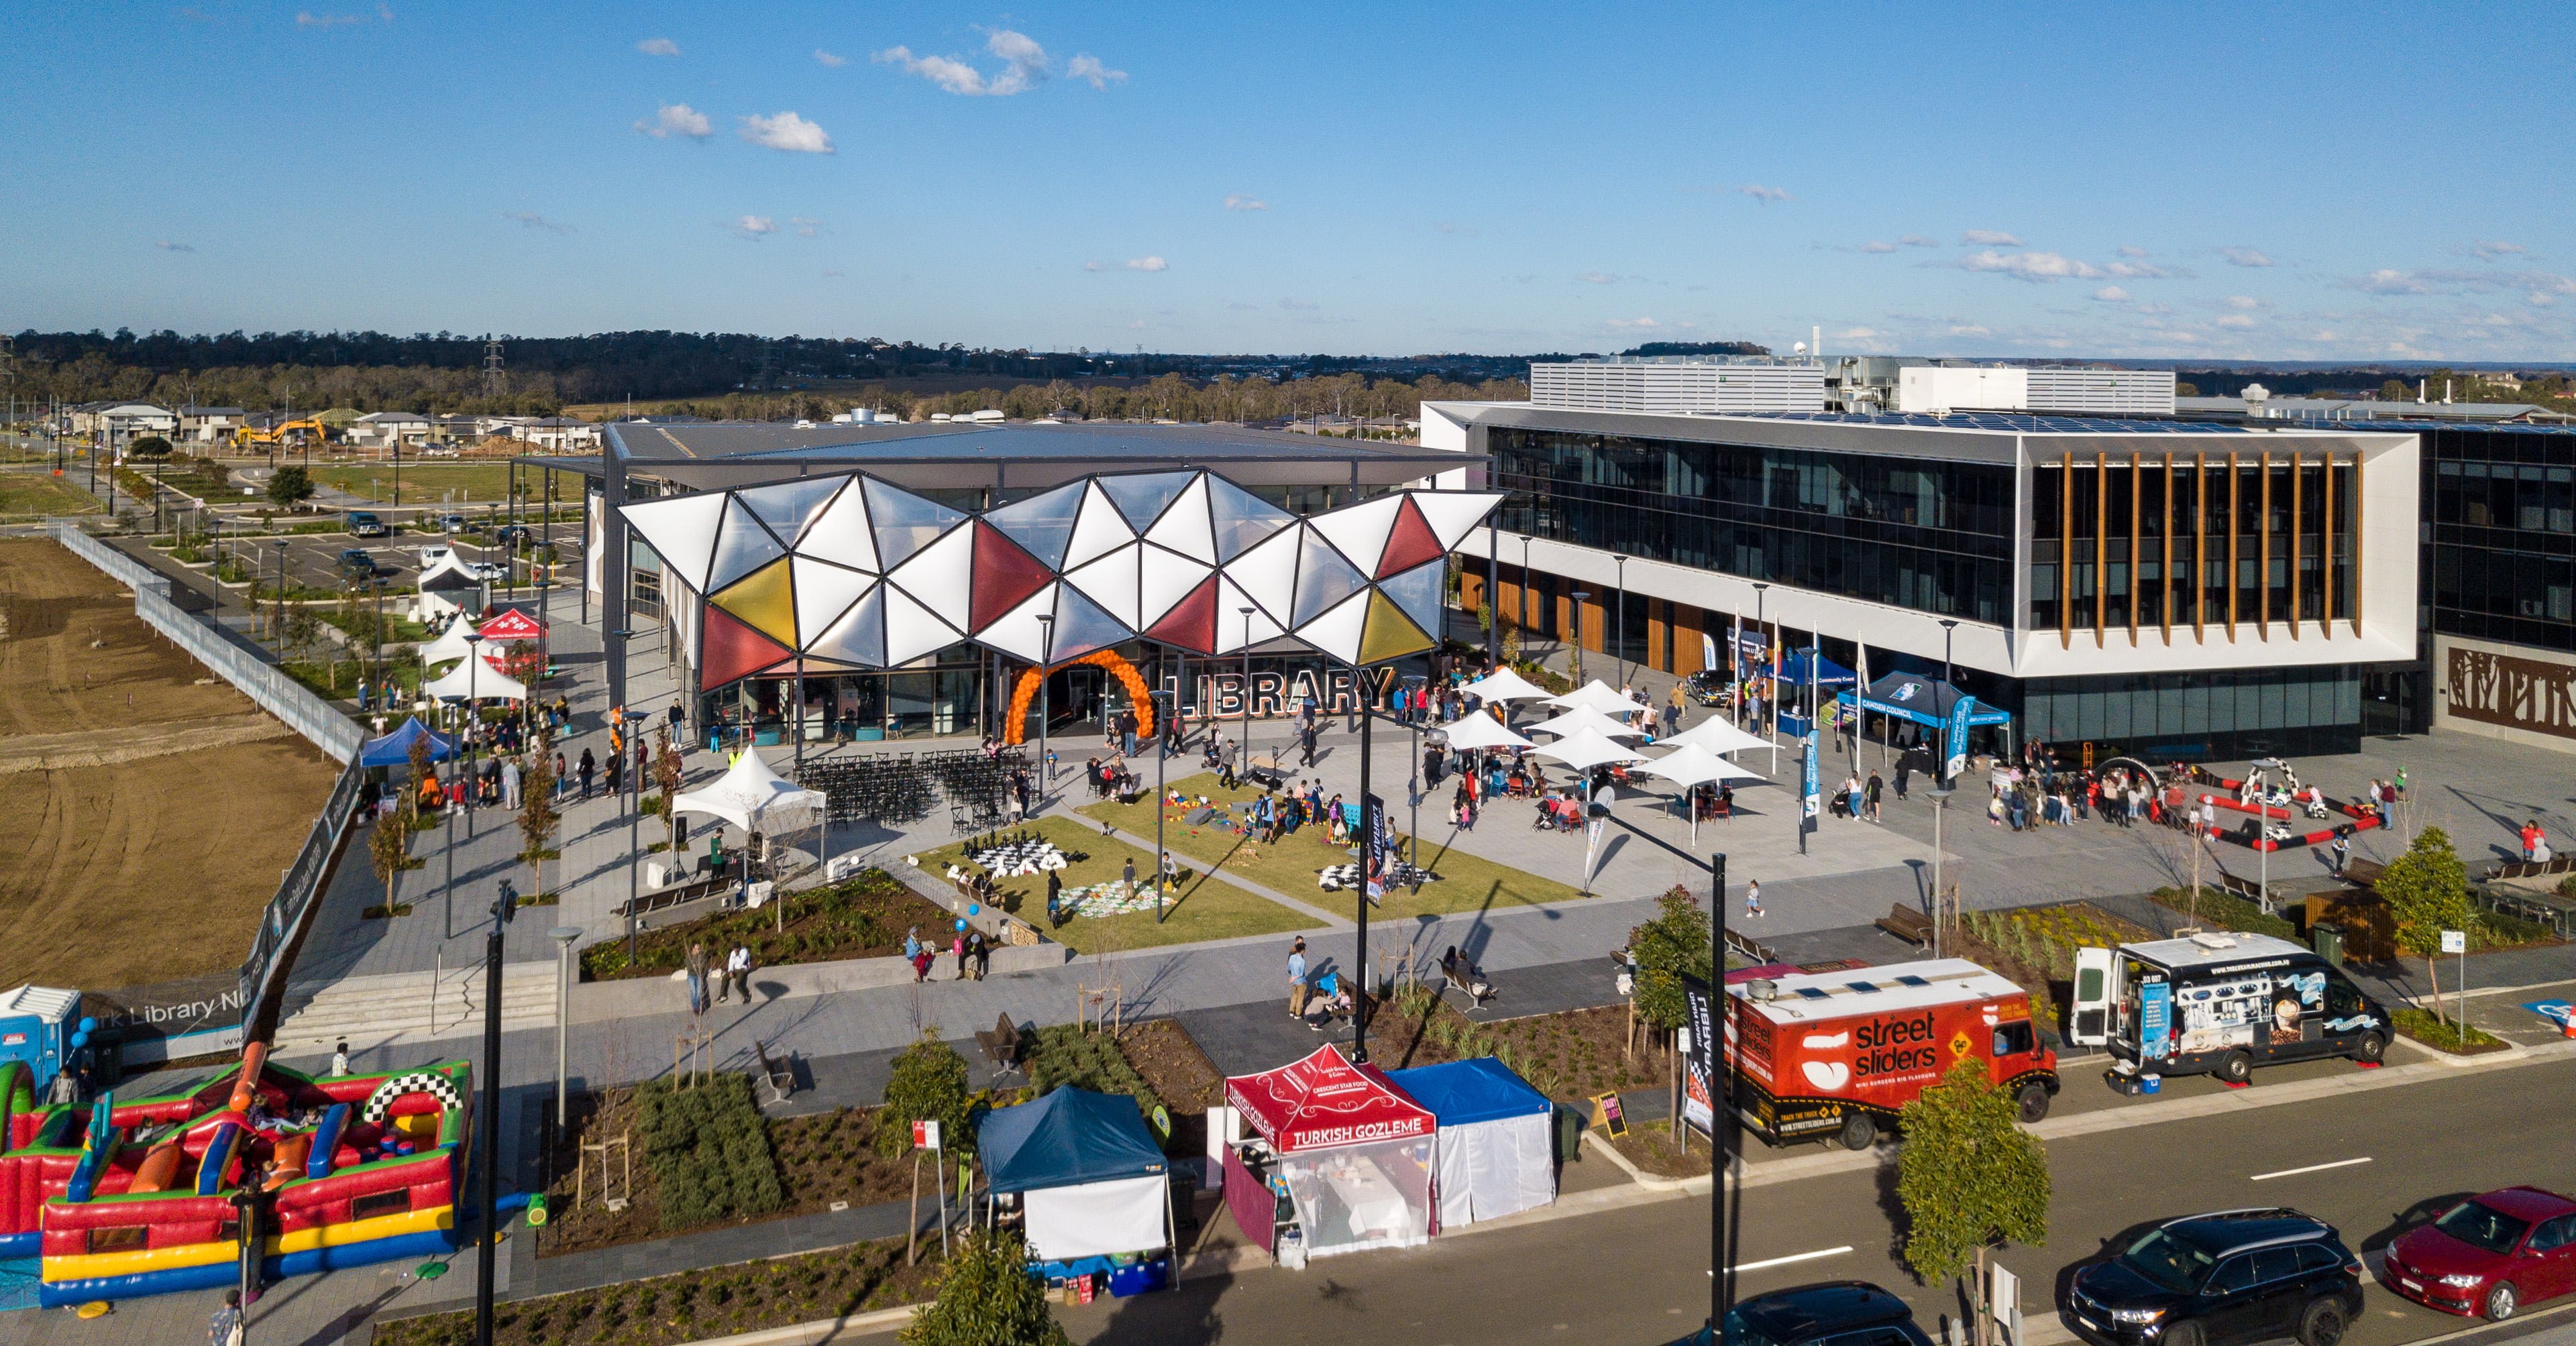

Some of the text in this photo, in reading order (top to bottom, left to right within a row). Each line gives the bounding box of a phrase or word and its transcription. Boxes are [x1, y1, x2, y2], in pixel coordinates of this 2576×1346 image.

[1165, 667, 1396, 720] LIBRARY
[1862, 699, 1913, 720] CAMDEN COUNCIL
[1372, 804, 1382, 865] LIBRARY
[129, 998, 215, 1025] Library
[1740, 1015, 1771, 1045] street
[1856, 1011, 1935, 1050] street
[1740, 1032, 1772, 1061] sliders
[1855, 1046, 1936, 1077] sliders
[1313, 1083, 1340, 1094] CRESCENT
[1340, 1082, 1352, 1090] STAR
[1229, 1083, 1275, 1142] TURKISH GOZLEME
[1293, 1127, 1352, 1145] TURKISH
[1355, 1117, 1421, 1138] GOZLEME
